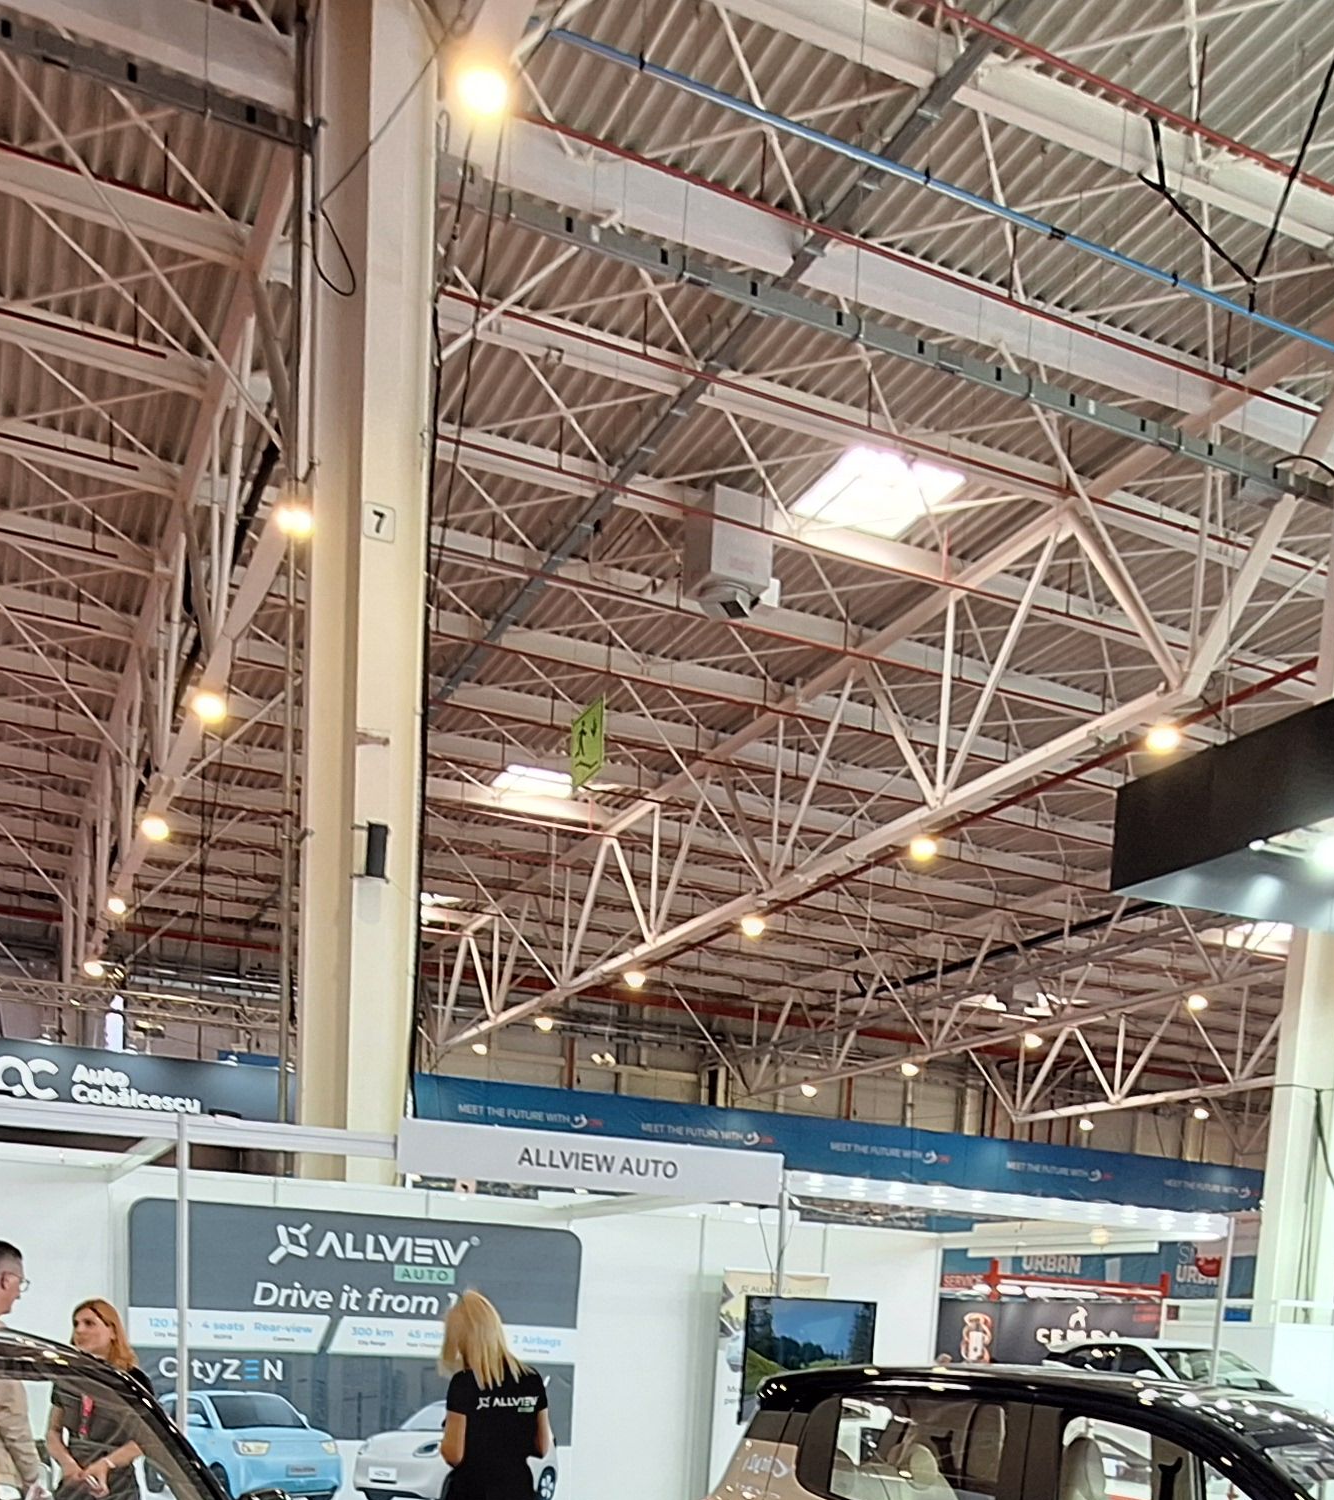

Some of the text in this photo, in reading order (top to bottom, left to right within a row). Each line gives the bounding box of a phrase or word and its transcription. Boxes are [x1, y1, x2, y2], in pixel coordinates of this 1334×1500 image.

[372, 509, 385, 534] 7
[71, 1064, 130, 1088] Auto
[458, 1103, 570, 1123] MEET THE FUTURE WITH
[517, 1147, 678, 1179] ALLVIEW AUTO
[316, 1231, 470, 1266] ALLVIEW
[1022, 1254, 1082, 1274] URBAN
[401, 1269, 449, 1281] AUTO
[253, 1281, 333, 1308] Drive
[338, 1284, 362, 1311] it
[367, 1288, 440, 1315] from
[213, 1322, 245, 1331] seats
[253, 1321, 313, 1333] Rear-view
[351, 1326, 394, 1337] 300 km
[158, 1356, 284, 1384] CtyZEN
[493, 1396, 539, 1408] ALLVIEW
